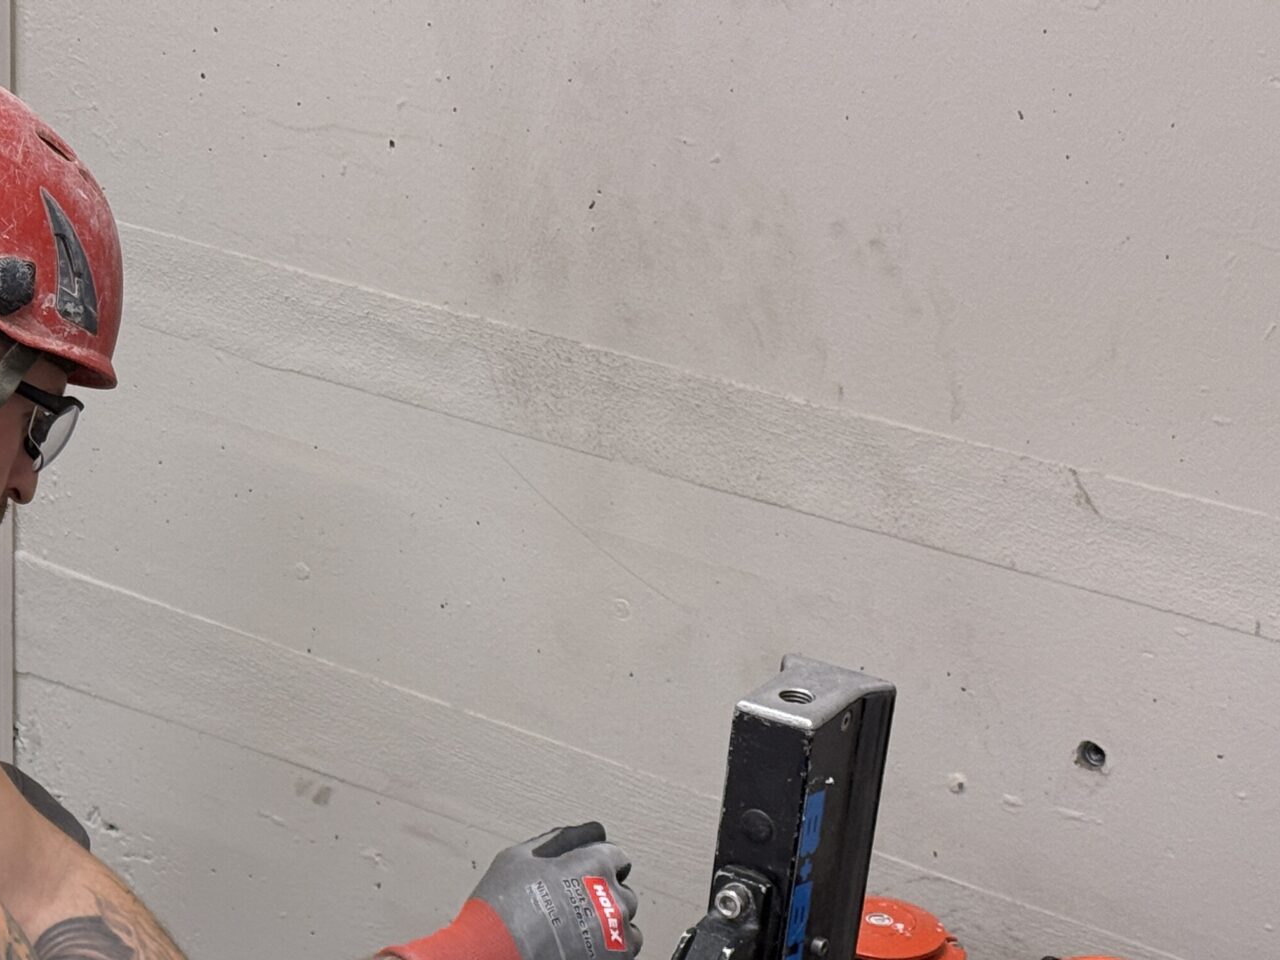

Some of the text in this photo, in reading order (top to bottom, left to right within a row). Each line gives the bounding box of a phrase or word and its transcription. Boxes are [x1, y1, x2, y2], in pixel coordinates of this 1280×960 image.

[536, 880, 562, 927] NITRILE
[563, 879, 595, 958] Protection
[571, 878, 595, 918] Cut C
[593, 884, 623, 944] HOLEX
